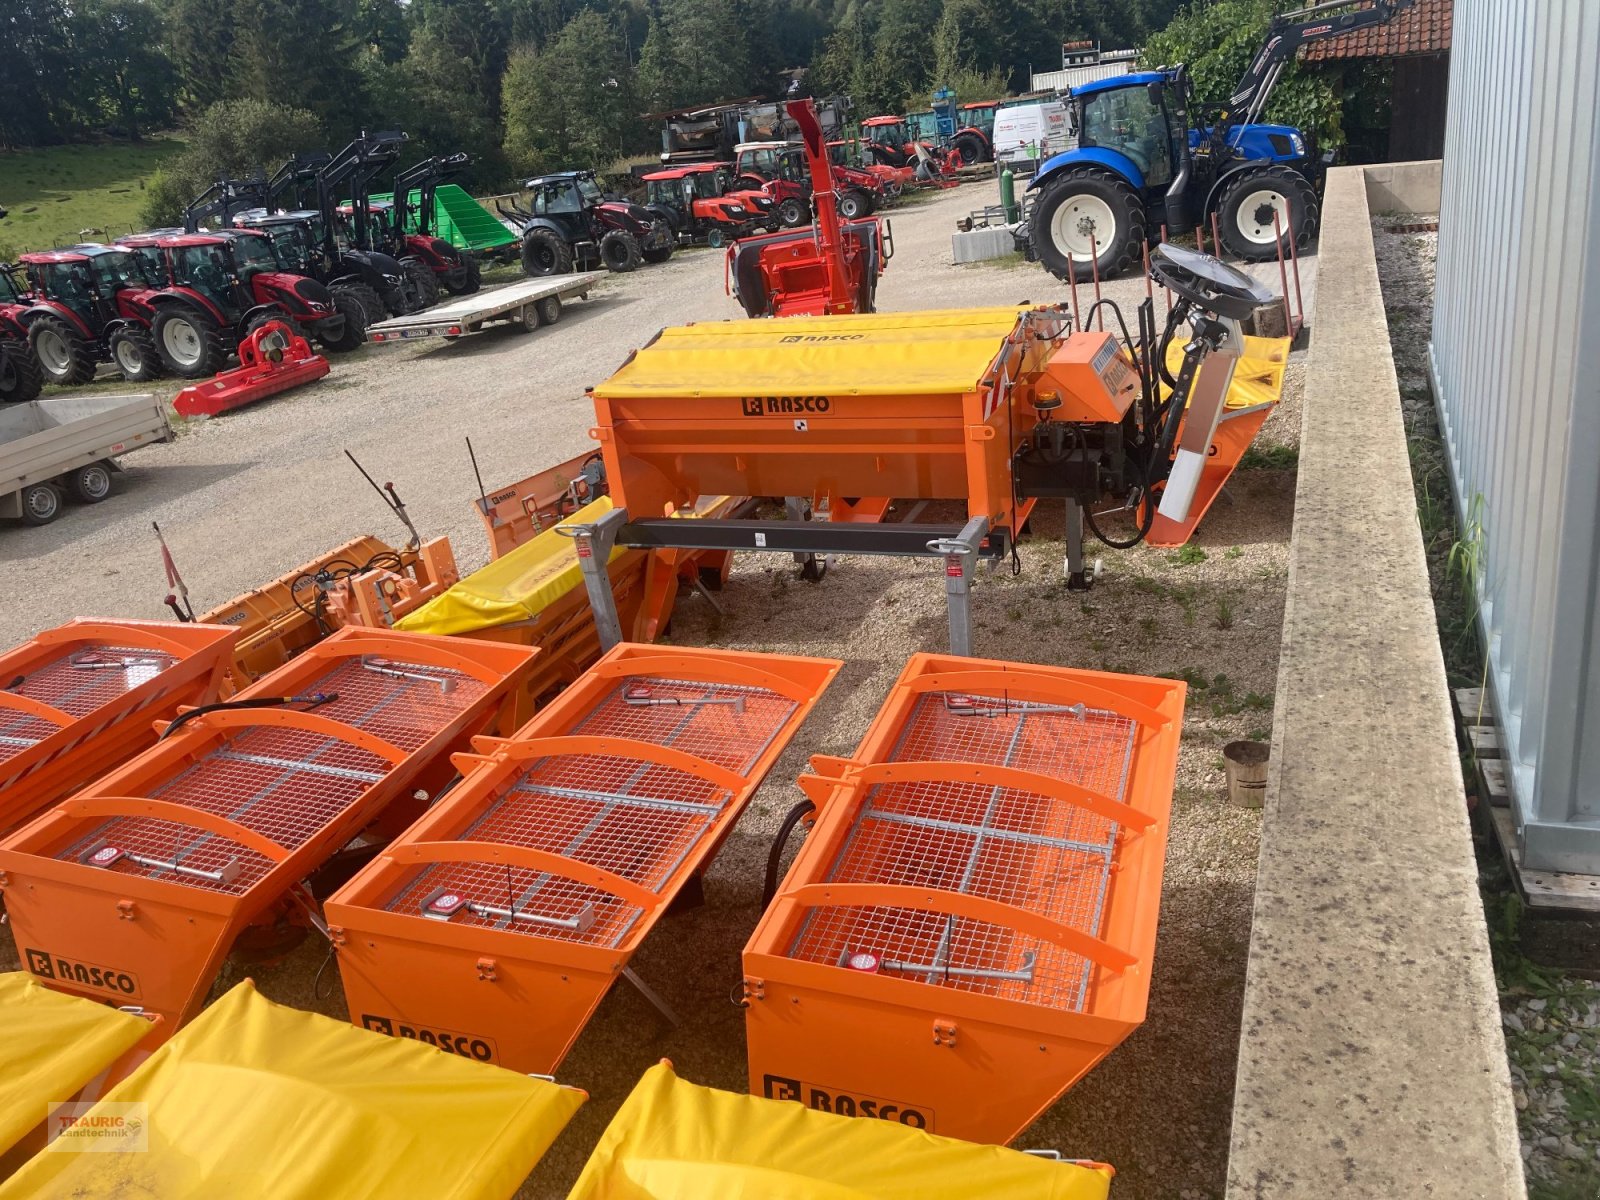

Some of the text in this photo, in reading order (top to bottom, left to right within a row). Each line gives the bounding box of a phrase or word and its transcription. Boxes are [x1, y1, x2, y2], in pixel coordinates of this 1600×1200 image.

[802, 334, 864, 342] RASCO
[767, 396, 830, 413] RASCO
[499, 491, 516, 501] RASCO
[56, 959, 135, 994] RASCO
